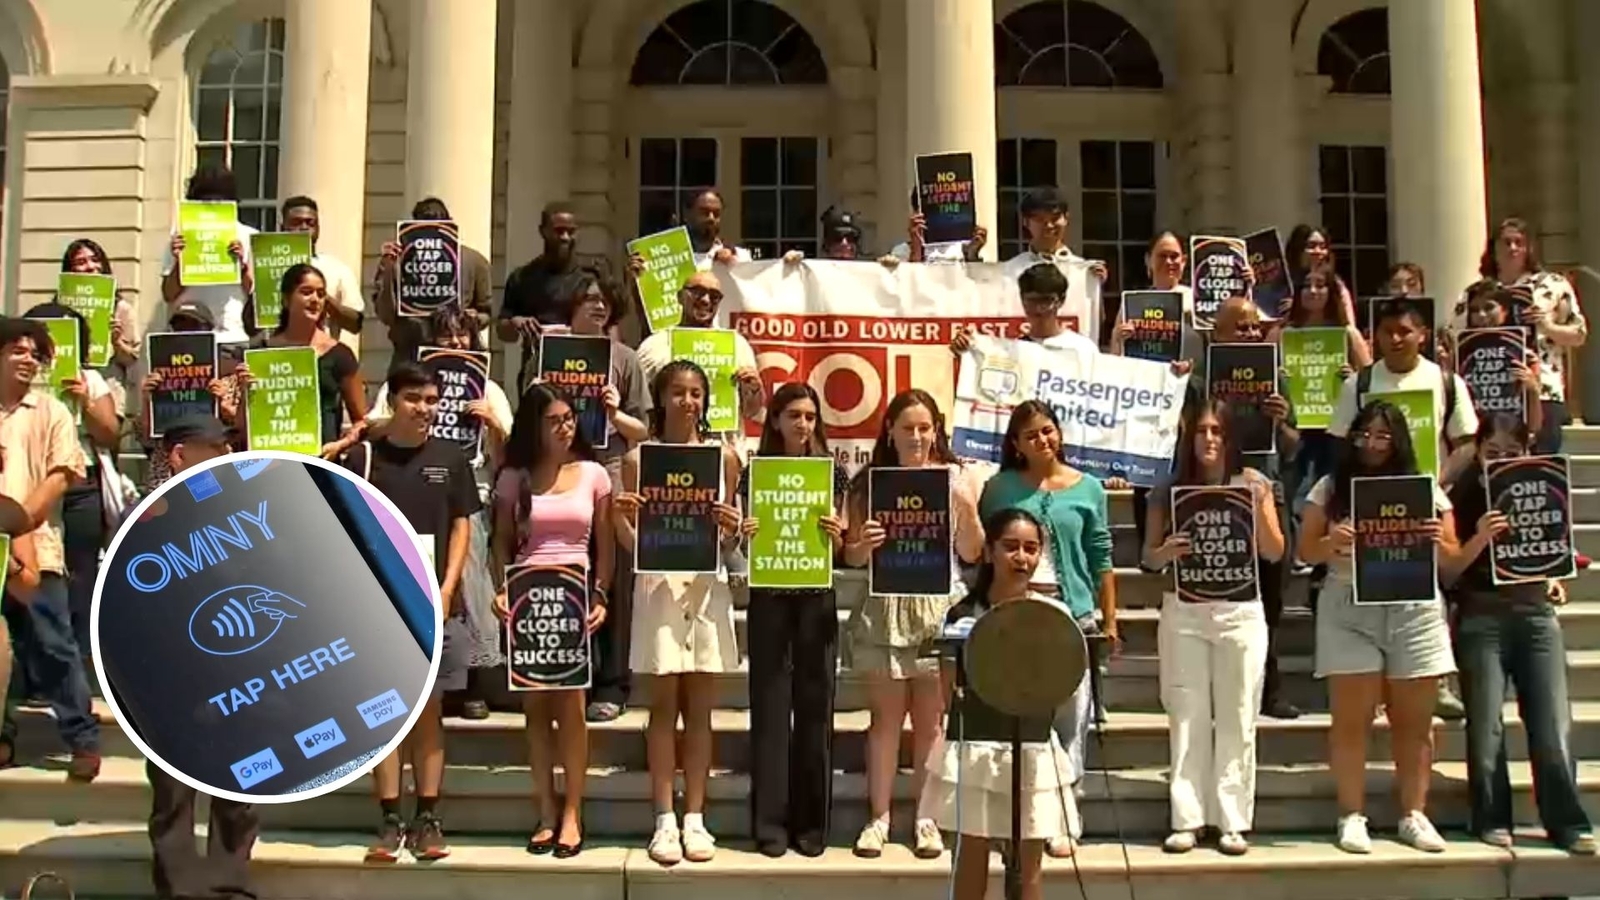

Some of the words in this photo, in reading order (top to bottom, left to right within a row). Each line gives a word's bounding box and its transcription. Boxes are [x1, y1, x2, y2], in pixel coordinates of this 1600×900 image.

[937, 171, 956, 182] NO
[272, 244, 290, 254] NO
[414, 238, 443, 250] ONE
[649, 243, 670, 257] NO
[256, 254, 308, 267] STUDENT
[416, 250, 441, 261] TAP
[650, 251, 690, 270] UDENT
[1207, 254, 1235, 266] ONE
[269, 268, 285, 280] LE
[404, 262, 453, 273] CLOSER
[1209, 266, 1233, 277] TAP
[419, 274, 438, 285] TO
[76, 284, 95, 295] NO
[402, 285, 456, 297] SUCCESS
[1213, 290, 1231, 300] TO
[662, 291, 679, 305] TH
[651, 302, 680, 320] STAT
[1143, 308, 1164, 319] NO
[735, 316, 796, 337] GOOD
[802, 318, 850, 339] OLD
[859, 321, 941, 341] LOWER
[692, 340, 716, 354] NO
[1302, 340, 1325, 353] NO
[1474, 347, 1507, 359] ONE
[171, 354, 195, 366] NO
[564, 359, 588, 372] NO
[1284, 353, 1344, 366] STUDENT
[153, 365, 213, 378] STUDENT
[269, 361, 293, 375] NO
[1231, 367, 1255, 380] NO
[1300, 365, 1329, 377] LEFT
[1476, 361, 1504, 373] TAP
[542, 371, 607, 386] STUDENT
[1306, 378, 1323, 390] AT
[1464, 373, 1512, 385] CLOSE
[170, 390, 197, 402] THE
[443, 385, 465, 398] AP
[1036, 368, 1176, 411] Passengers
[1481, 386, 1502, 398] TO
[267, 390, 297, 404] LEFT
[1303, 391, 1328, 403] THE
[274, 405, 292, 417] AT
[1295, 403, 1334, 416] TATIO
[1476, 398, 1523, 412] CCESS
[269, 419, 297, 432] THE
[437, 412, 459, 425] TO
[428, 425, 477, 440] CCESS
[253, 432, 315, 448] STATION
[666, 472, 695, 487] NO
[777, 473, 806, 488] NO
[642, 486, 718, 502] STUDENT
[1510, 480, 1548, 497] ONE
[754, 489, 829, 505] STUDENT
[896, 495, 924, 510] NO
[1513, 496, 1547, 512] TAP
[648, 502, 685, 515] LEFT
[688, 503, 708, 515] AT
[773, 507, 809, 521] LEFT
[1379, 503, 1407, 517] NO
[662, 517, 695, 531] THE
[874, 510, 947, 525] STUDENT
[1194, 510, 1232, 526] ONE
[1510, 509, 1563, 527] LOSER
[779, 523, 801, 537] AT
[1358, 518, 1421, 533] STUDEN
[1196, 526, 1231, 540] TAP
[1518, 526, 1544, 541] TO
[125, 499, 275, 593] OMNY
[774, 539, 806, 554] THE
[896, 540, 927, 553] THE
[1194, 539, 1247, 554] LOSER
[1496, 540, 1569, 560] SUCCESS
[754, 555, 826, 571] STATION
[1202, 554, 1228, 568] TO
[1180, 567, 1253, 582] SUCCESS
[528, 587, 566, 602] ONE
[531, 603, 564, 617] TAP
[515, 618, 581, 634] CLOSER
[536, 634, 561, 648] TO
[513, 648, 586, 665] SUCCESS
[207, 676, 266, 717] TAP
[270, 636, 357, 691] HERE
[361, 695, 397, 716] SAMSUNG
[373, 704, 394, 721] pay
[313, 728, 337, 745] Pay
[252, 757, 274, 774] Pay
